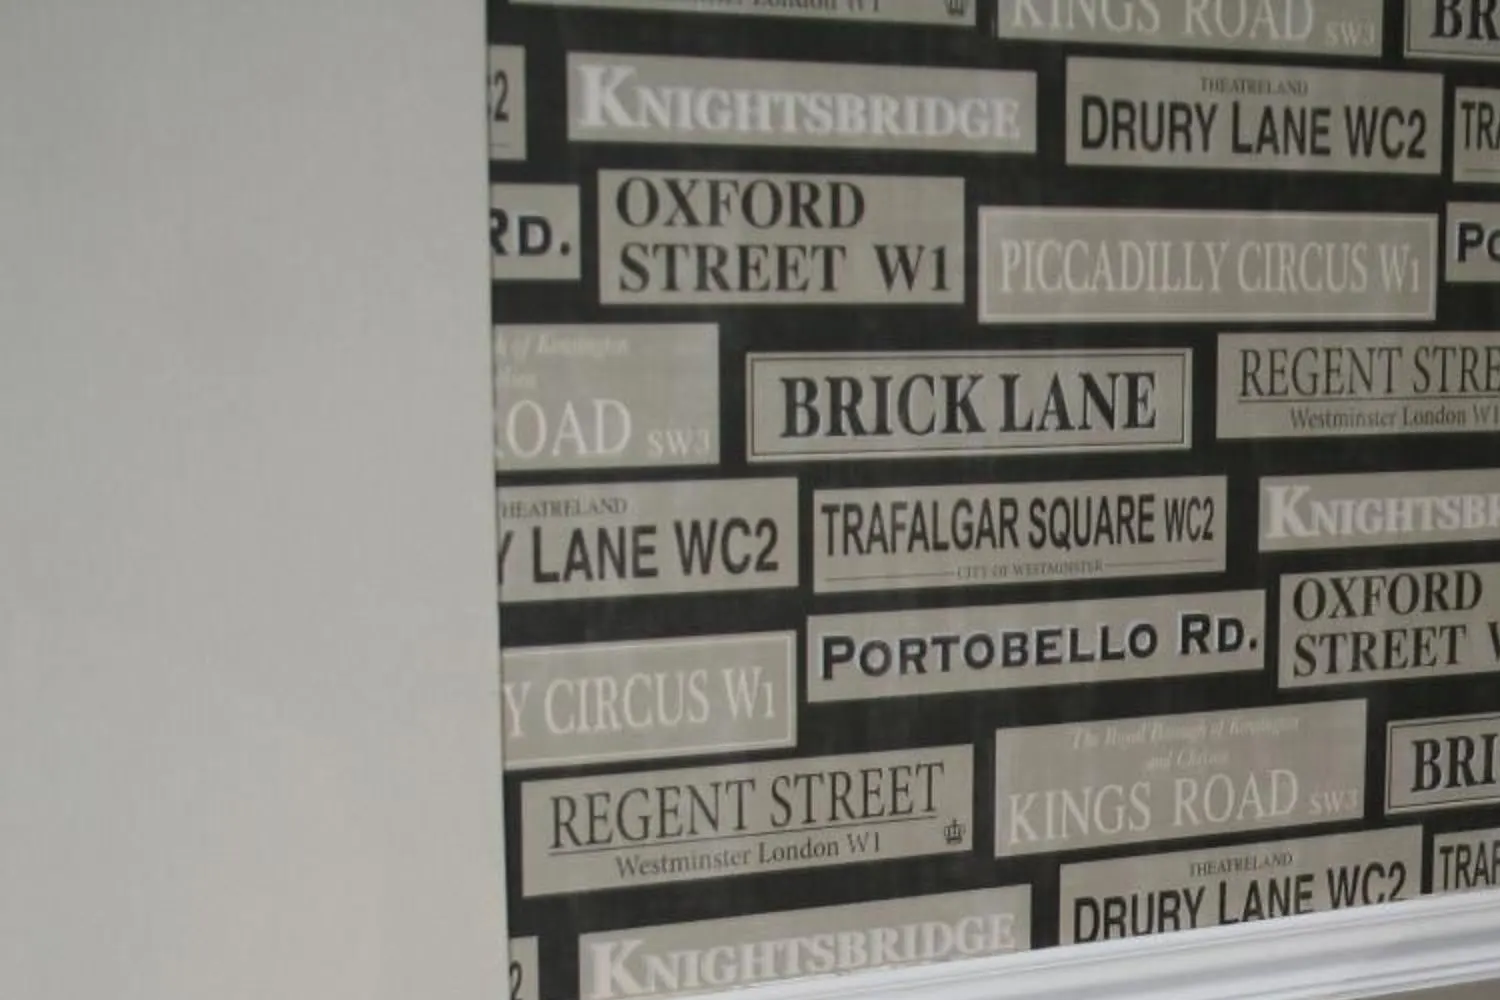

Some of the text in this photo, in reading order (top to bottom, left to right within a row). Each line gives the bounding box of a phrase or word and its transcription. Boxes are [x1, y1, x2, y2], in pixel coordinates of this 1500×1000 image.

[576, 64, 1021, 140] KNIGHTSBRIDGE
[1200, 77, 1309, 96] THEATRELAND
[1082, 96, 1427, 159] DRURY LANE WC2
[616, 177, 865, 229] OXFORD
[620, 243, 950, 293] STREET W1
[1002, 238, 1420, 294] PICCADILLY CIRCUS W1
[1240, 346, 1402, 397] REGENT
[780, 371, 1156, 437] BRICK LANE
[1290, 404, 1499, 430] Westminster London W1
[532, 525, 658, 583] LANE
[674, 517, 779, 576] WC2
[821, 494, 1215, 556] TRAFALGAR SQUARE WC2
[1293, 570, 1483, 621] OXFORD
[822, 613, 1257, 680] PORTOBELLO RD.
[1293, 624, 1466, 679] STREET
[545, 667, 709, 735] CIRCUS
[723, 666, 776, 722] W1
[550, 762, 944, 850] REGENT STREET
[1007, 782, 1151, 845] KINGS
[1173, 768, 1298, 827] ROAD
[616, 831, 880, 878] Westminster London W1
[1189, 851, 1293, 877] THEATRELAND
[1074, 860, 1407, 944] DRURY LANE WC2
[590, 913, 1014, 1000] KNIGHTSBRIDGE
